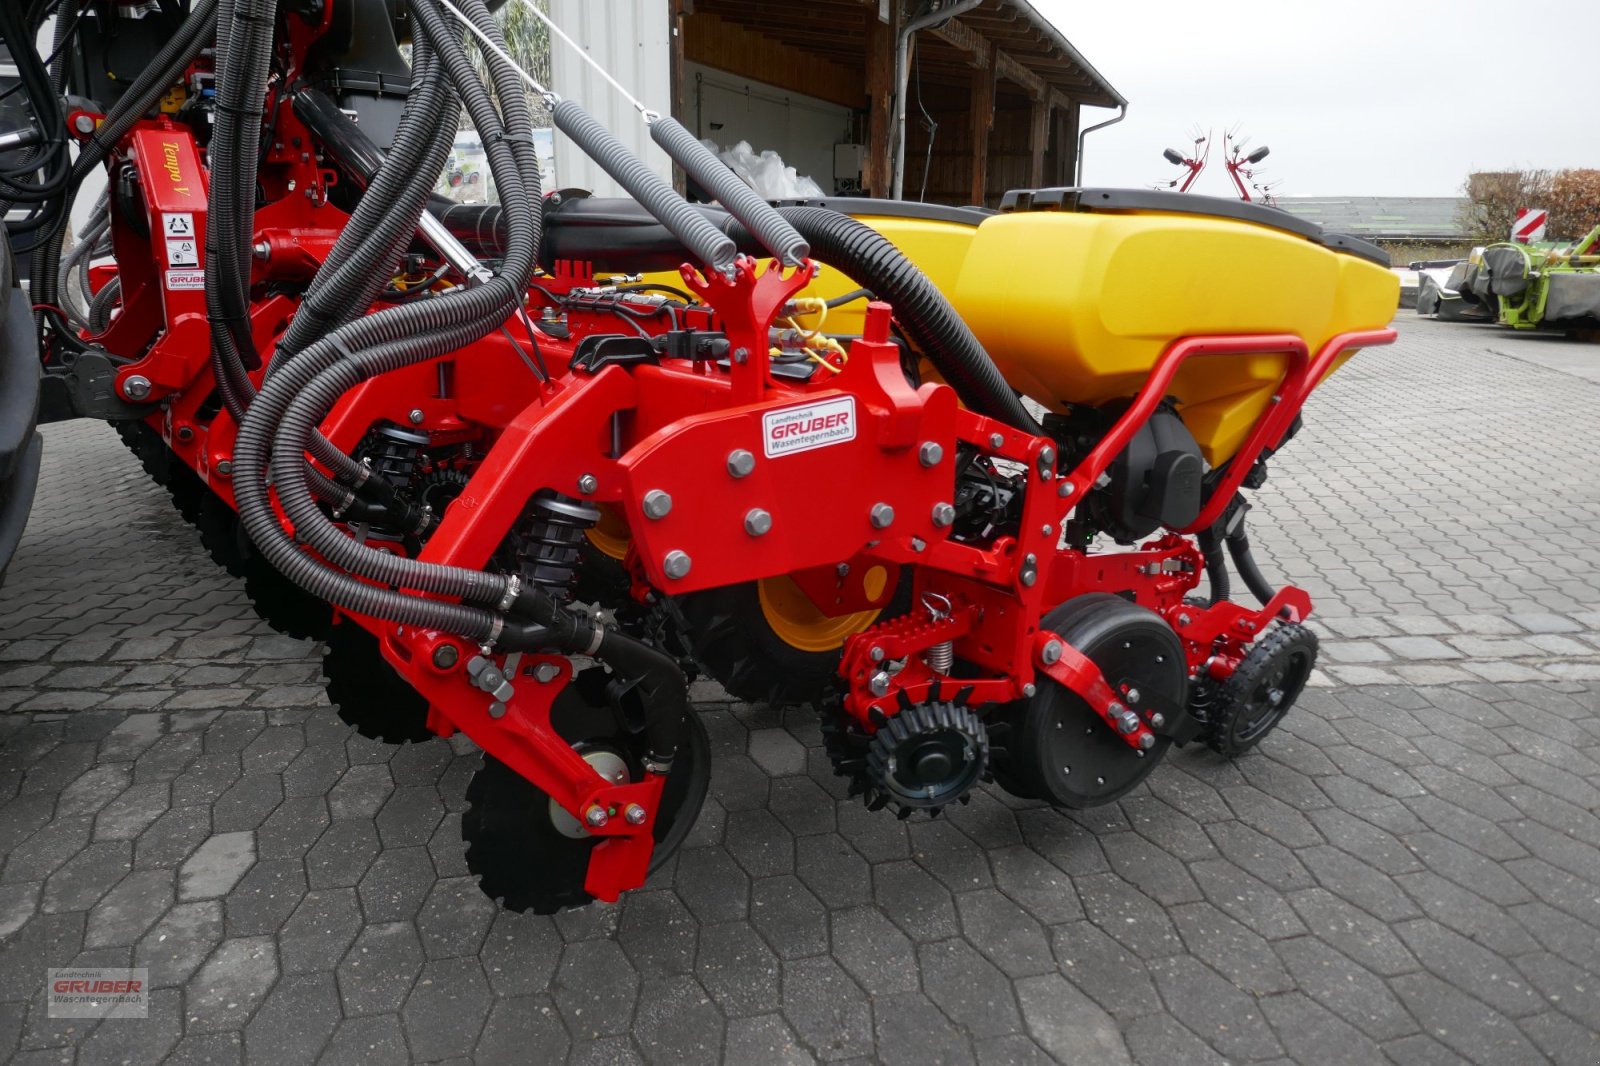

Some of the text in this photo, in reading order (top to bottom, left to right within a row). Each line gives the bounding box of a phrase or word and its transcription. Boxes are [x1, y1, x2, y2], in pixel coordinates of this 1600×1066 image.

[163, 142, 191, 197] Tempo V
[170, 276, 205, 284] GRUBE
[771, 411, 813, 426] Landtechnik
[771, 412, 849, 440] GRUBER
[771, 426, 850, 449] Wasentegernbach
